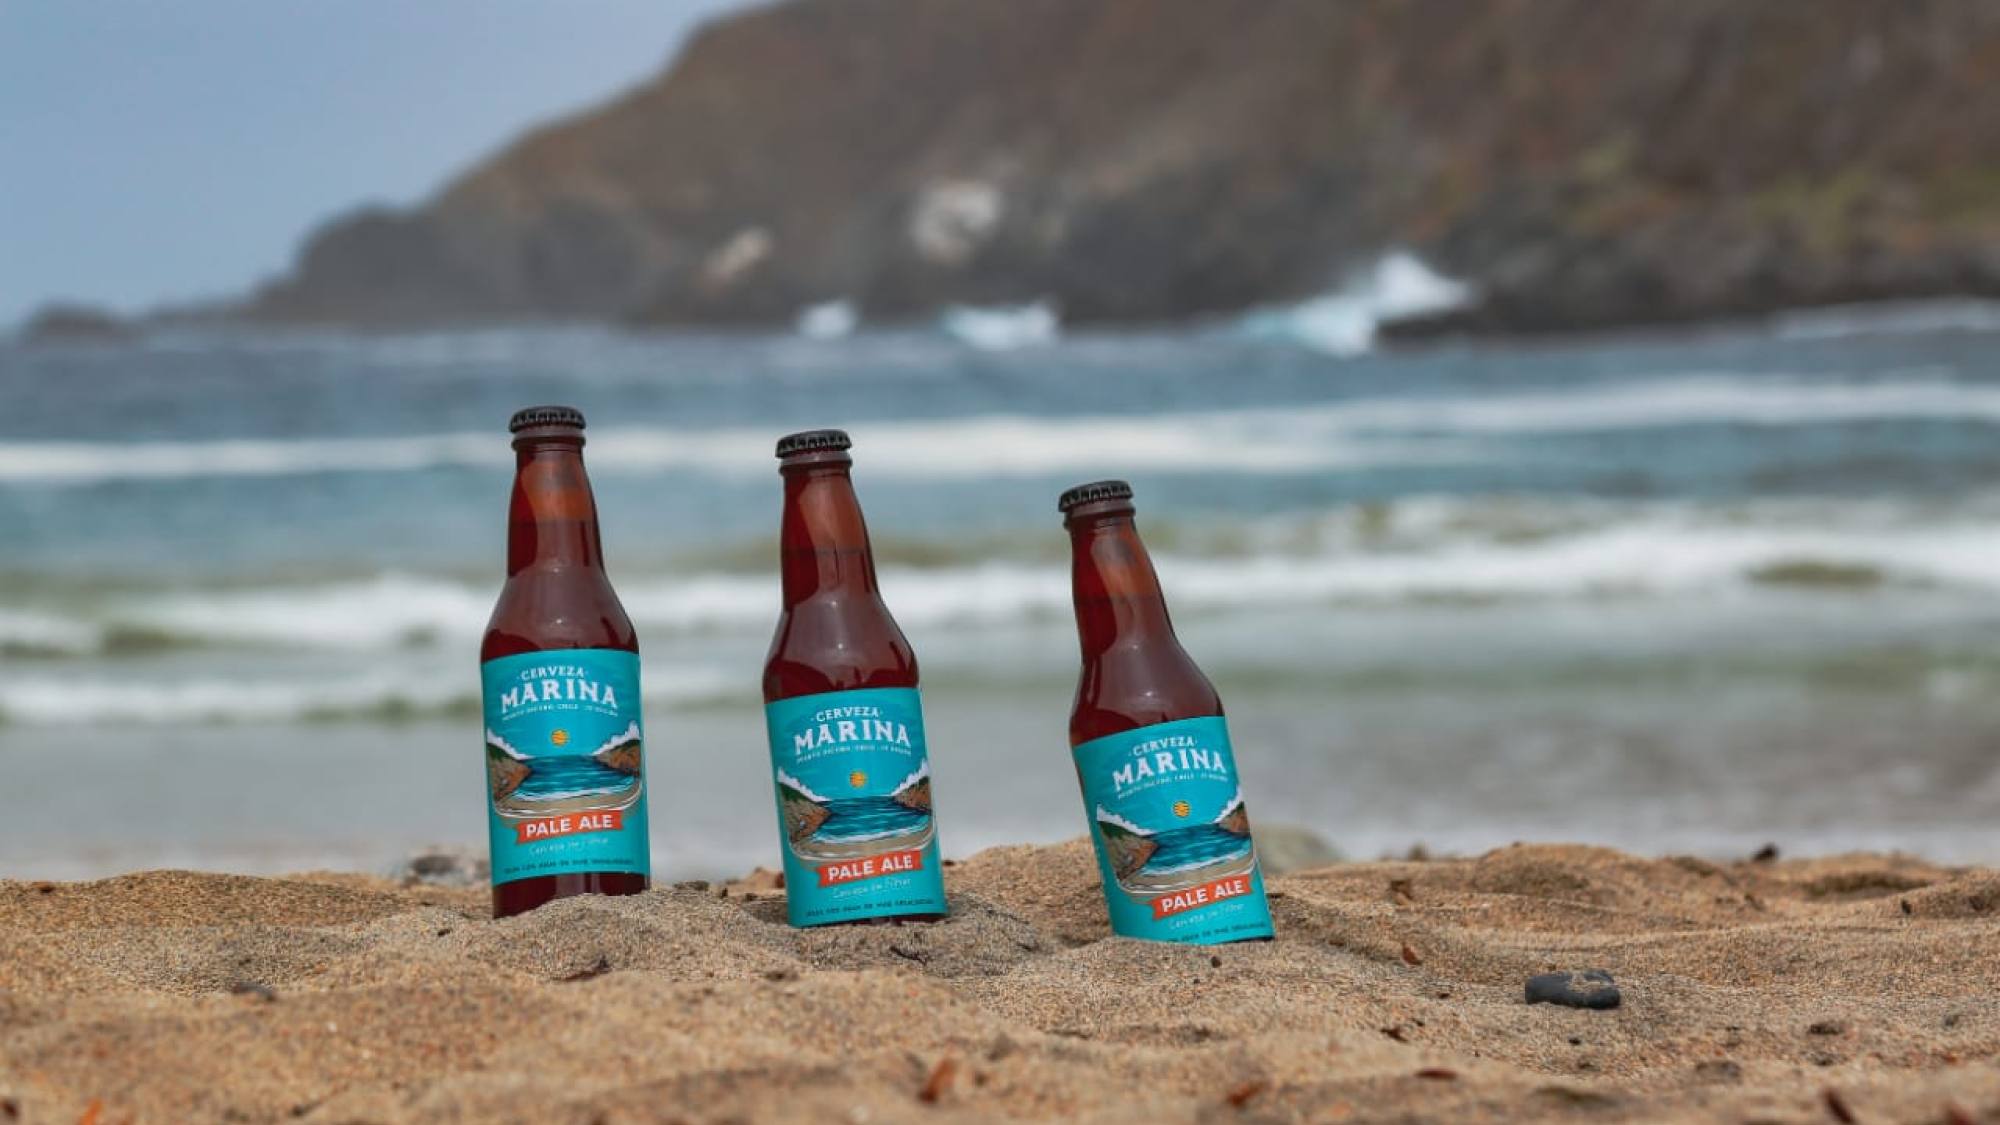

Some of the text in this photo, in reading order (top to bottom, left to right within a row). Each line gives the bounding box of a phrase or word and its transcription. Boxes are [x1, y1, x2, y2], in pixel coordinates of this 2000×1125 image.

[521, 665, 584, 681] CERVEZA
[501, 678, 618, 714] MARINA
[816, 706, 880, 722] CERVEZA
[794, 719, 912, 756] MARINA
[1133, 736, 1195, 756] CERVEZA
[1112, 749, 1227, 791] MARINA
[526, 814, 613, 838] PALE ALE
[827, 854, 913, 881] PALE ALE
[1161, 888, 1209, 913] PALE
[1214, 880, 1245, 898] ALE
